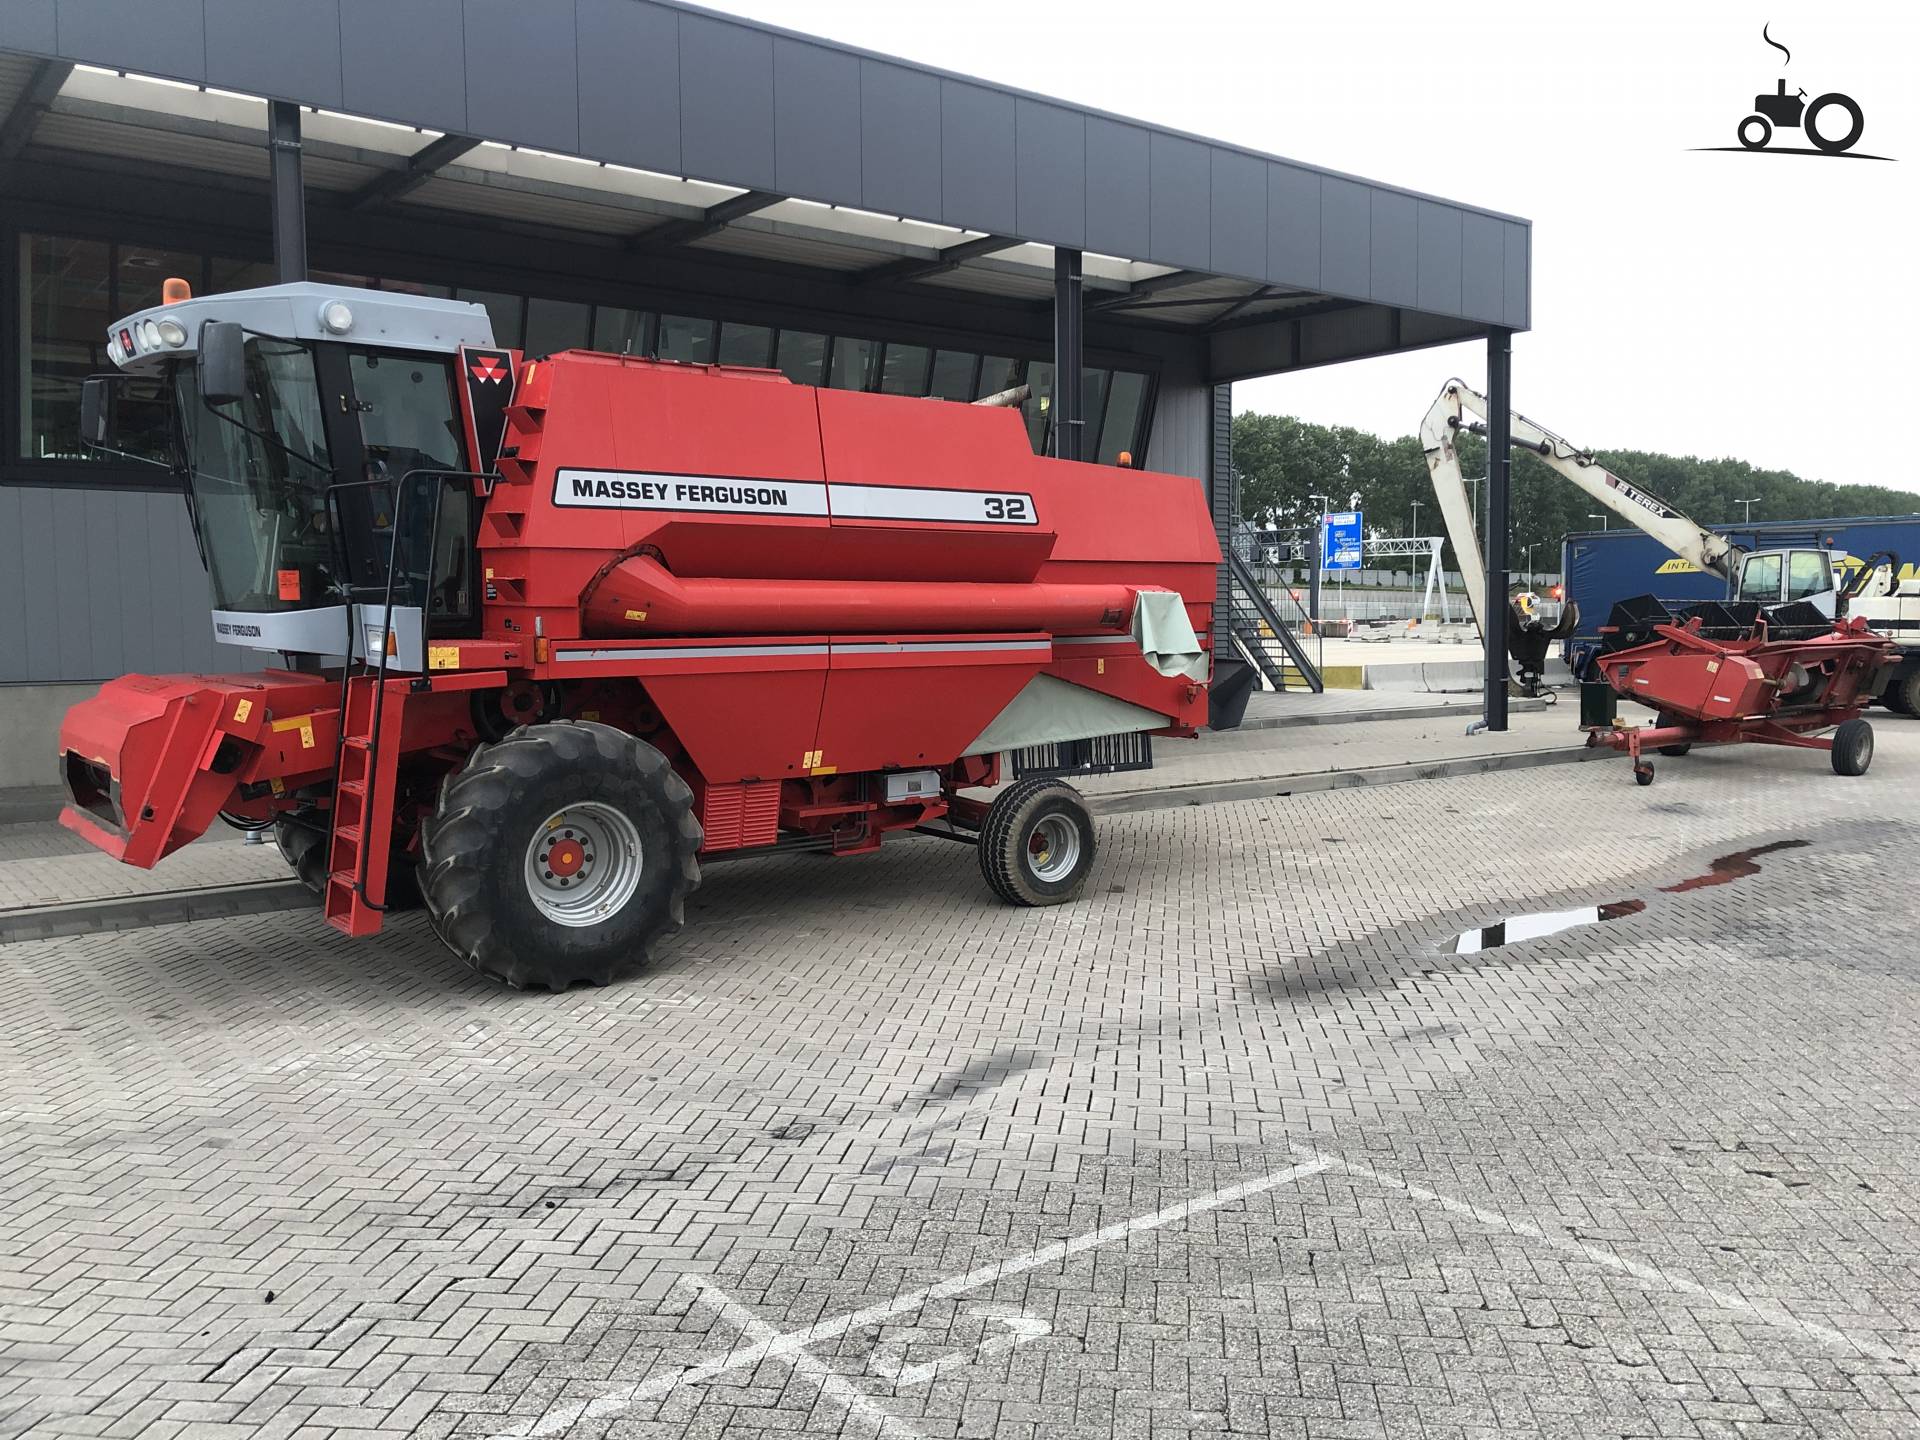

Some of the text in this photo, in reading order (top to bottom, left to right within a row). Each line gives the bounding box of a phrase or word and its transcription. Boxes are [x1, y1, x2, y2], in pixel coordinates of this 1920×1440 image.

[571, 479, 788, 506] MASSEY FERGUSON
[1629, 489, 1668, 517] TEREX
[984, 497, 1026, 520] 32
[232, 624, 261, 637] FERGUSON
